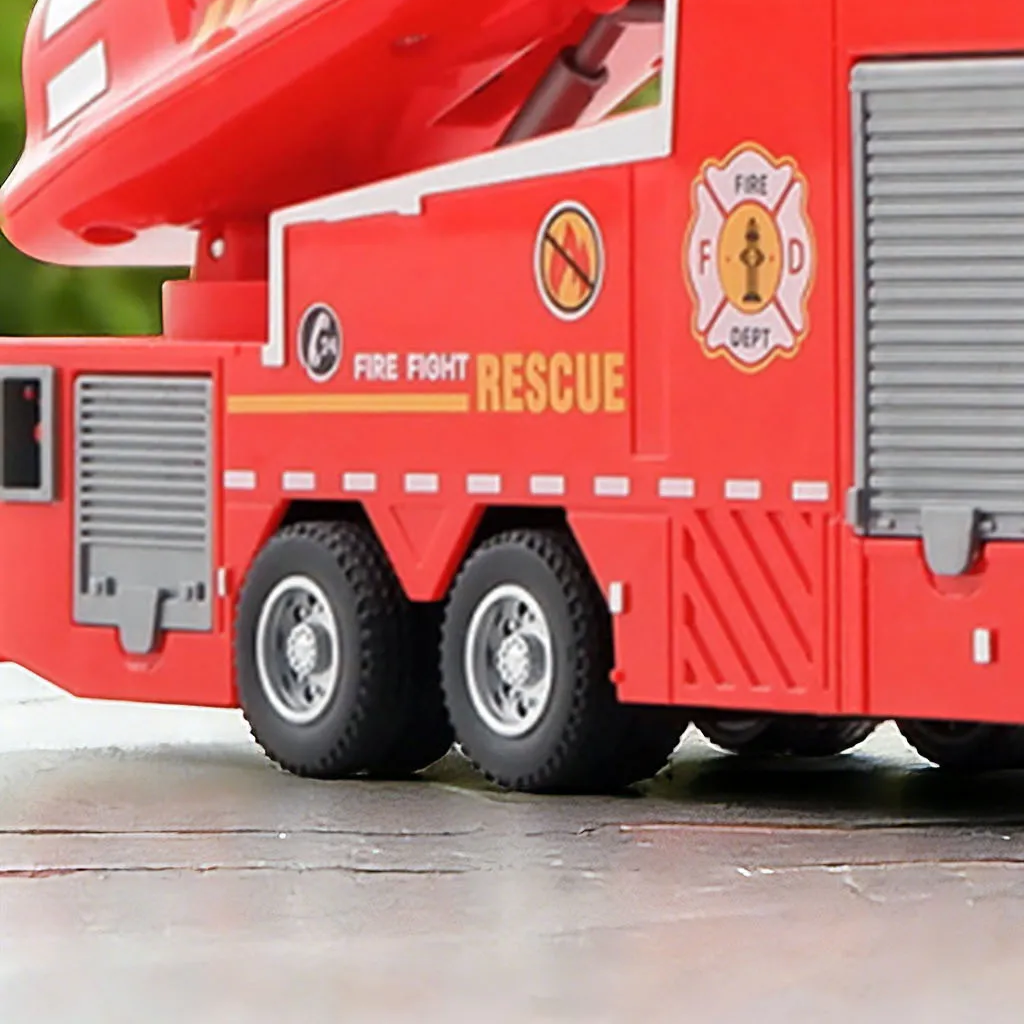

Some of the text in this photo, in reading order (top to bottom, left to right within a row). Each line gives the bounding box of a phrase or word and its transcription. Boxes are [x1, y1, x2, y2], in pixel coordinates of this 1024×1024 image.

[735, 174, 768, 196] FIRE
[700, 238, 805, 275] F D
[730, 326, 771, 349] DEPT
[354, 352, 626, 414] FIRE FIGHT RESCUE
